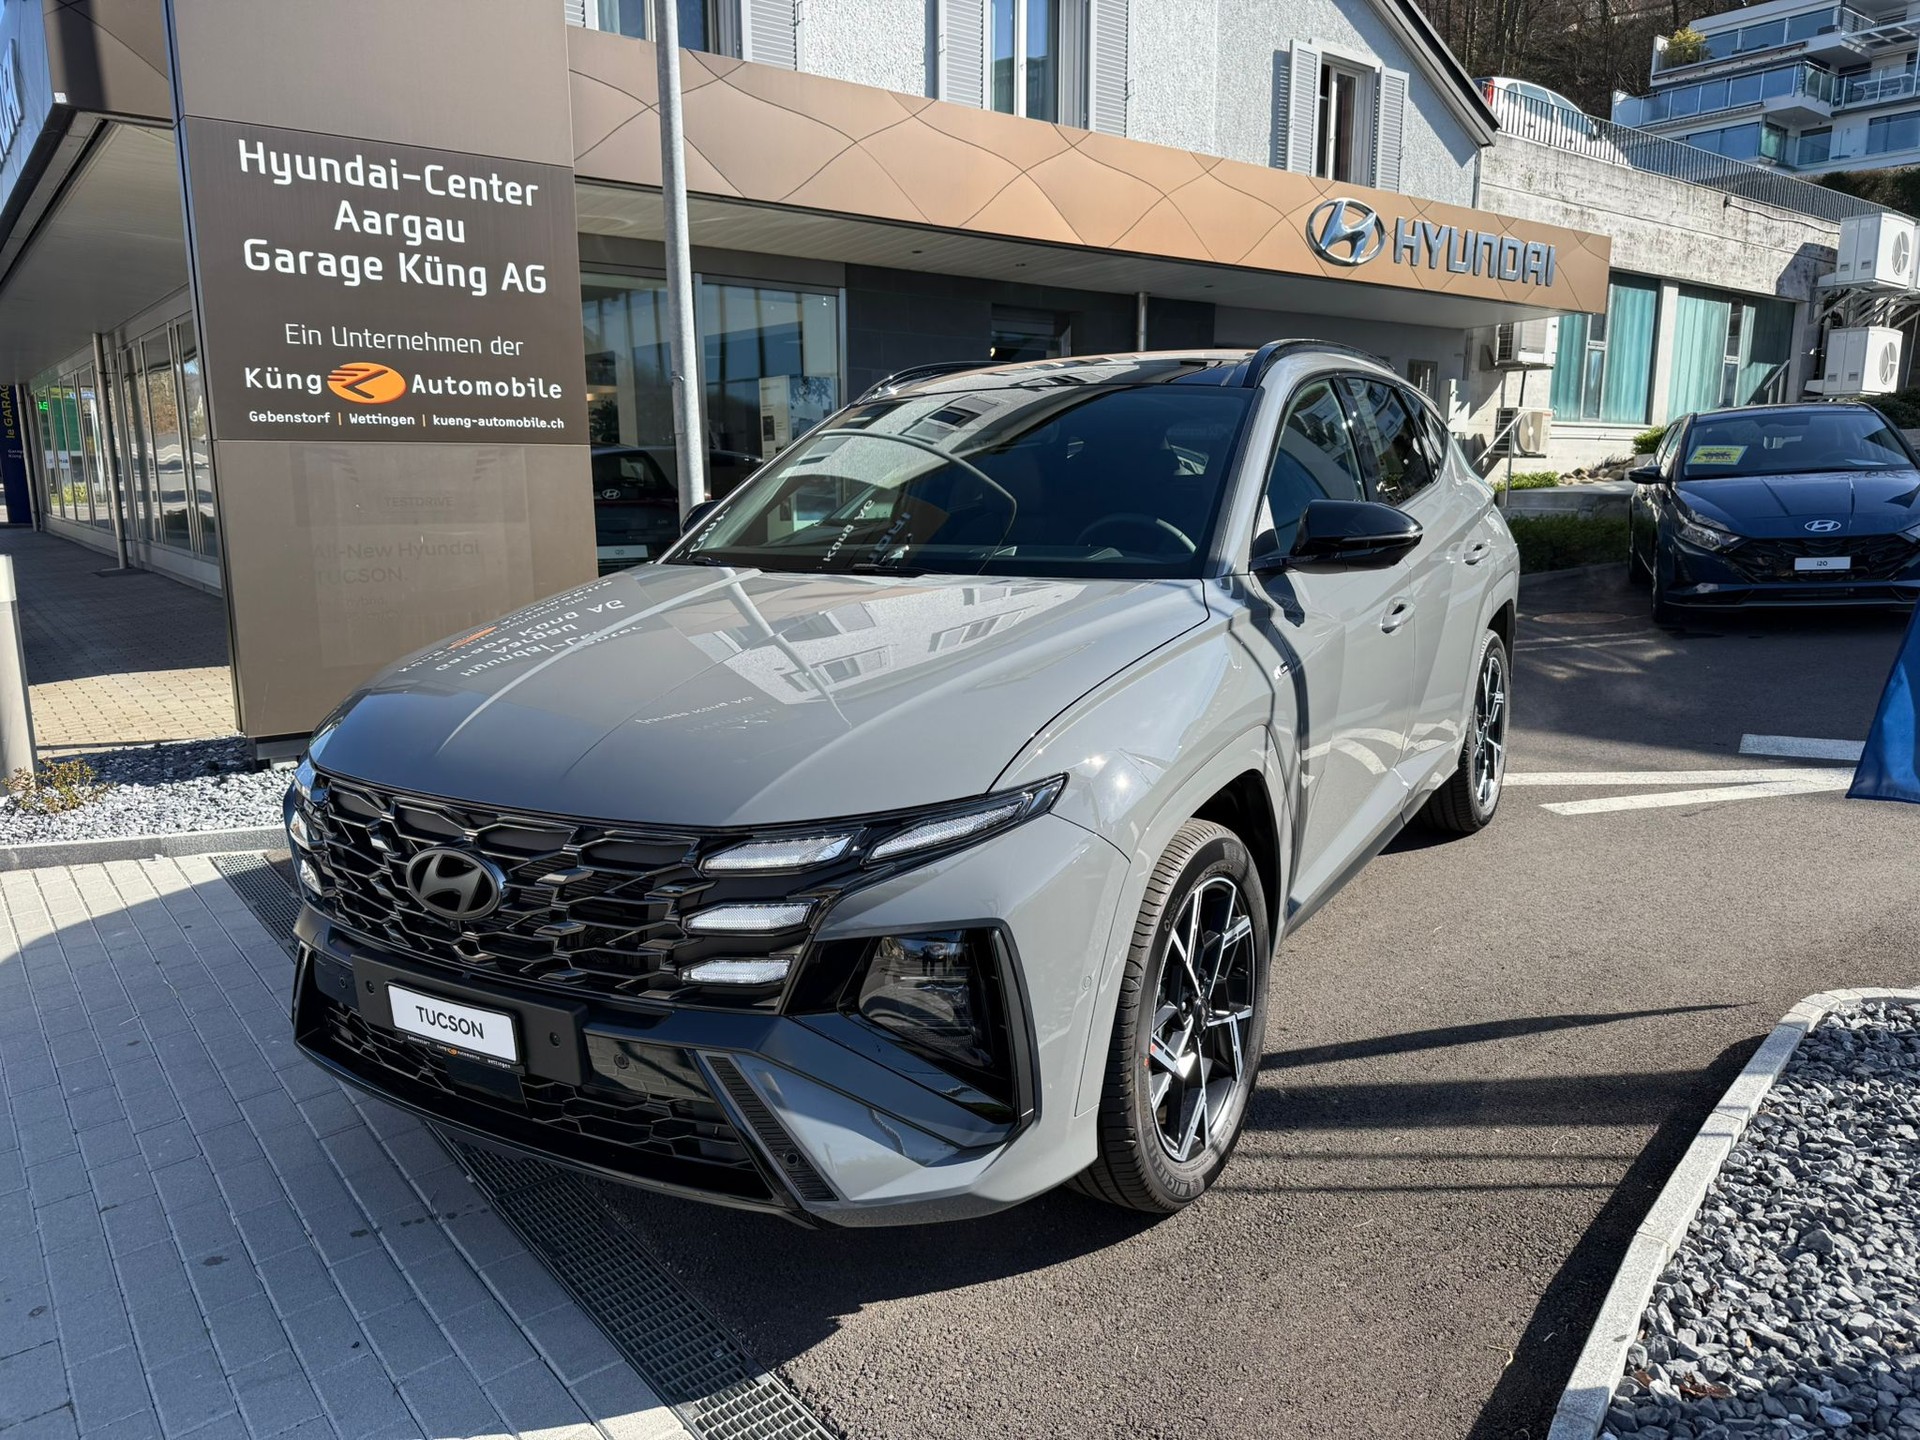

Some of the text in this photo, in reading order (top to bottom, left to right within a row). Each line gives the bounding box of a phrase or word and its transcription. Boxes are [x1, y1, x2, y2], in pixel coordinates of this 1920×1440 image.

[238, 139, 538, 207] Hyundai-Center
[334, 200, 465, 246] Aargau
[243, 238, 547, 297] Garage Küng AG
[1393, 216, 1556, 287] HYUNDAI
[285, 323, 524, 356] Ein Unternehmen der
[244, 367, 562, 399] Küng Automobile
[249, 409, 565, 430] Gebenstorf Wettingen kueng-automobile.ch
[399, 539, 481, 560] Hyundai
[415, 1005, 485, 1040] TUCSON
